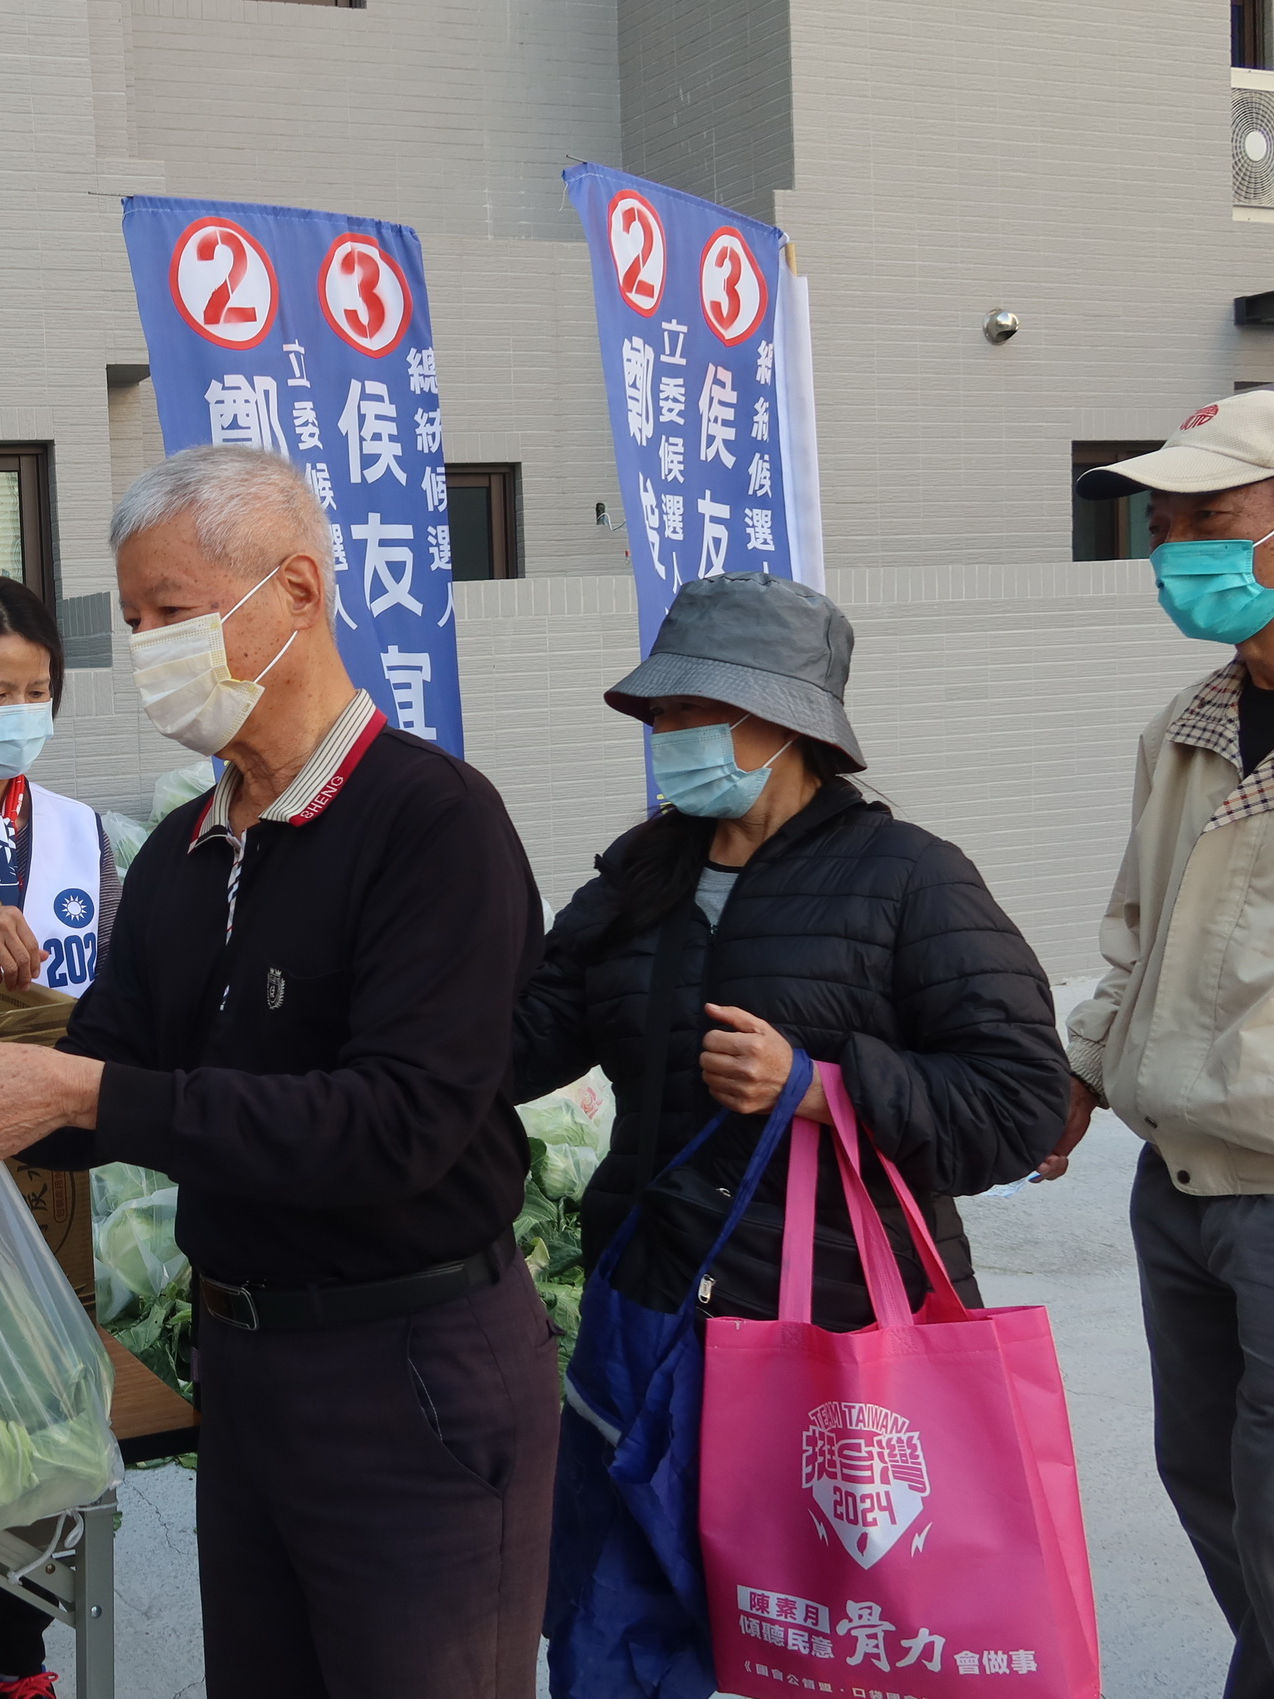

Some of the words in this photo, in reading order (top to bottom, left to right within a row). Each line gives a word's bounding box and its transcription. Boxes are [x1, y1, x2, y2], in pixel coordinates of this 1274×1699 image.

[196, 229, 257, 325] 2
[622, 206, 655, 298] 2
[709, 245, 743, 331] 3
[339, 244, 385, 340] 3
[338, 378, 437, 741] 侯友宜
[300, 774, 344, 820] SHENG
[809, 1402, 843, 1430] TEAM
[842, 1402, 910, 1436] TAIWAN
[833, 1485, 897, 1527] 2024
[738, 1614, 835, 1659] 傾聽民意
[748, 1591, 820, 1627] 陳素月
[836, 1600, 946, 1672] 骨力
[953, 1649, 1038, 1675] 會做事
